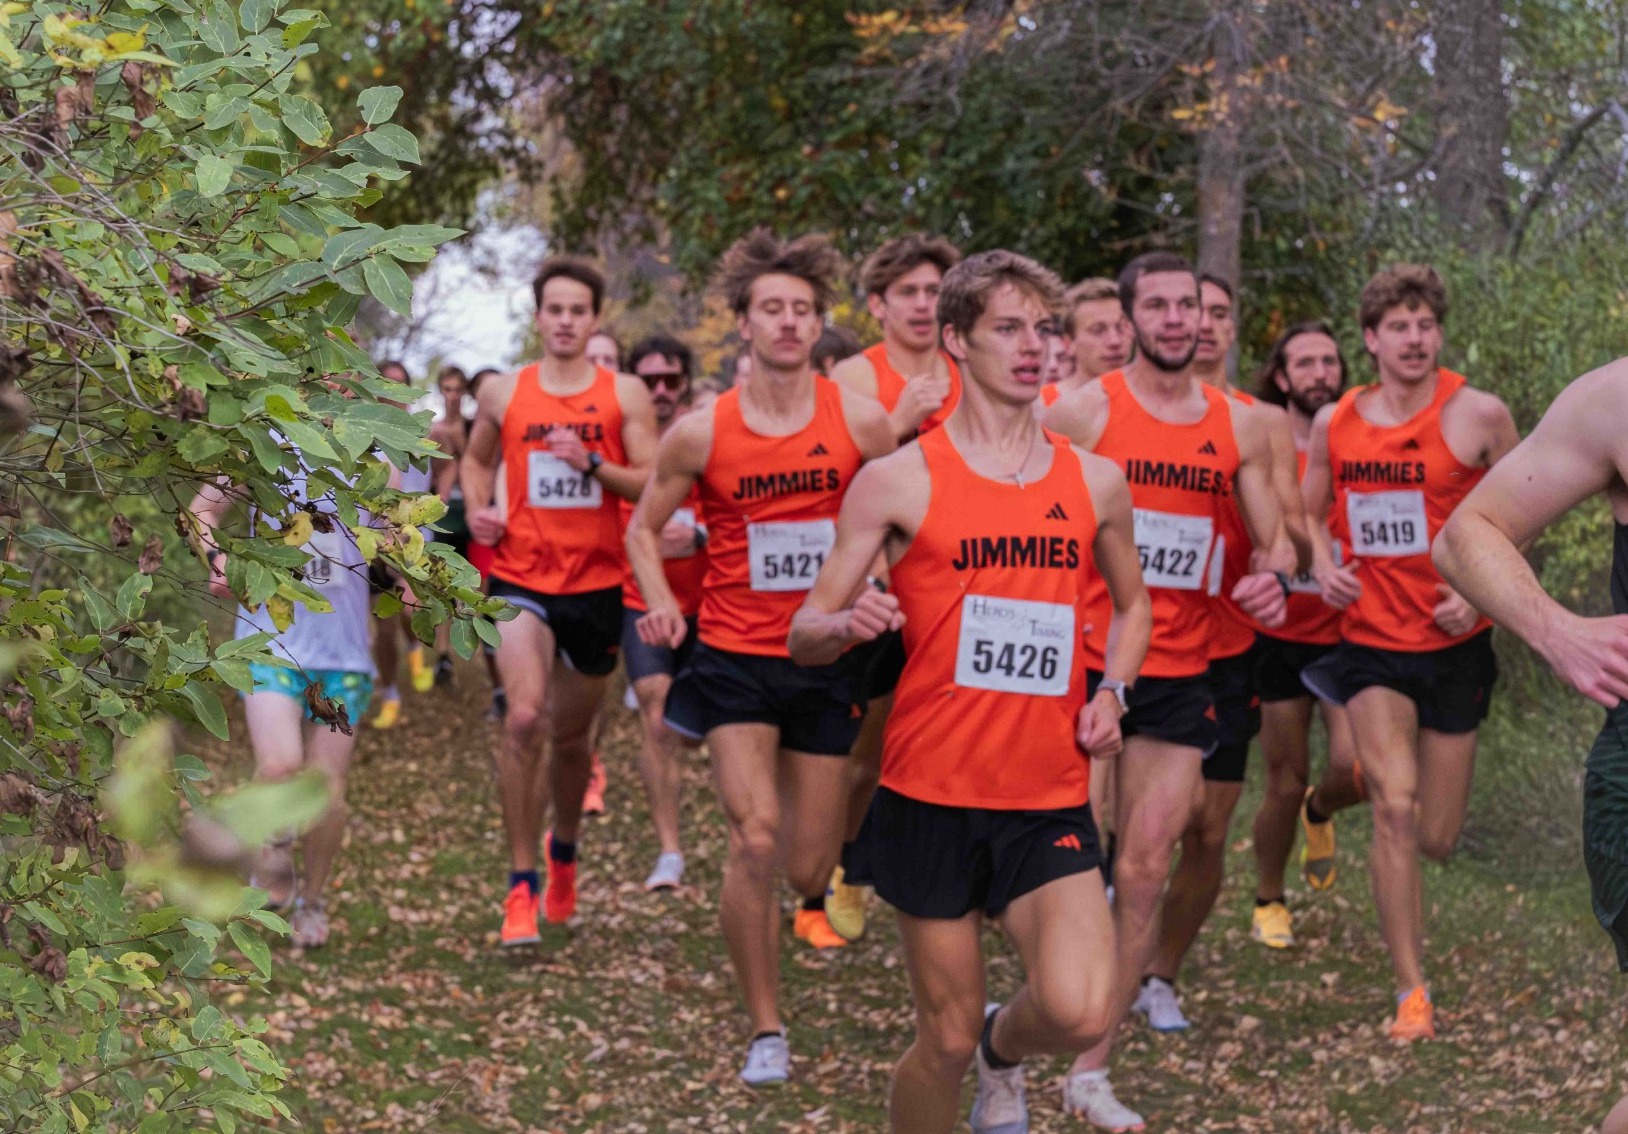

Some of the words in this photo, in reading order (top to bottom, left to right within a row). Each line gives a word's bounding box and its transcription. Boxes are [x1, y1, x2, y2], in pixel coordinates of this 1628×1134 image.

[522, 423, 604, 442] JIMIES
[733, 468, 839, 500] JIMMIES
[1126, 458, 1223, 496] JIMMIES
[1340, 460, 1425, 484] JIMMIES
[1361, 521, 1415, 546] 5419
[764, 551, 824, 579] 5421
[952, 535, 1079, 571] JIMMIES
[1137, 545, 1197, 578] 5422
[972, 638, 1058, 681] 5426
